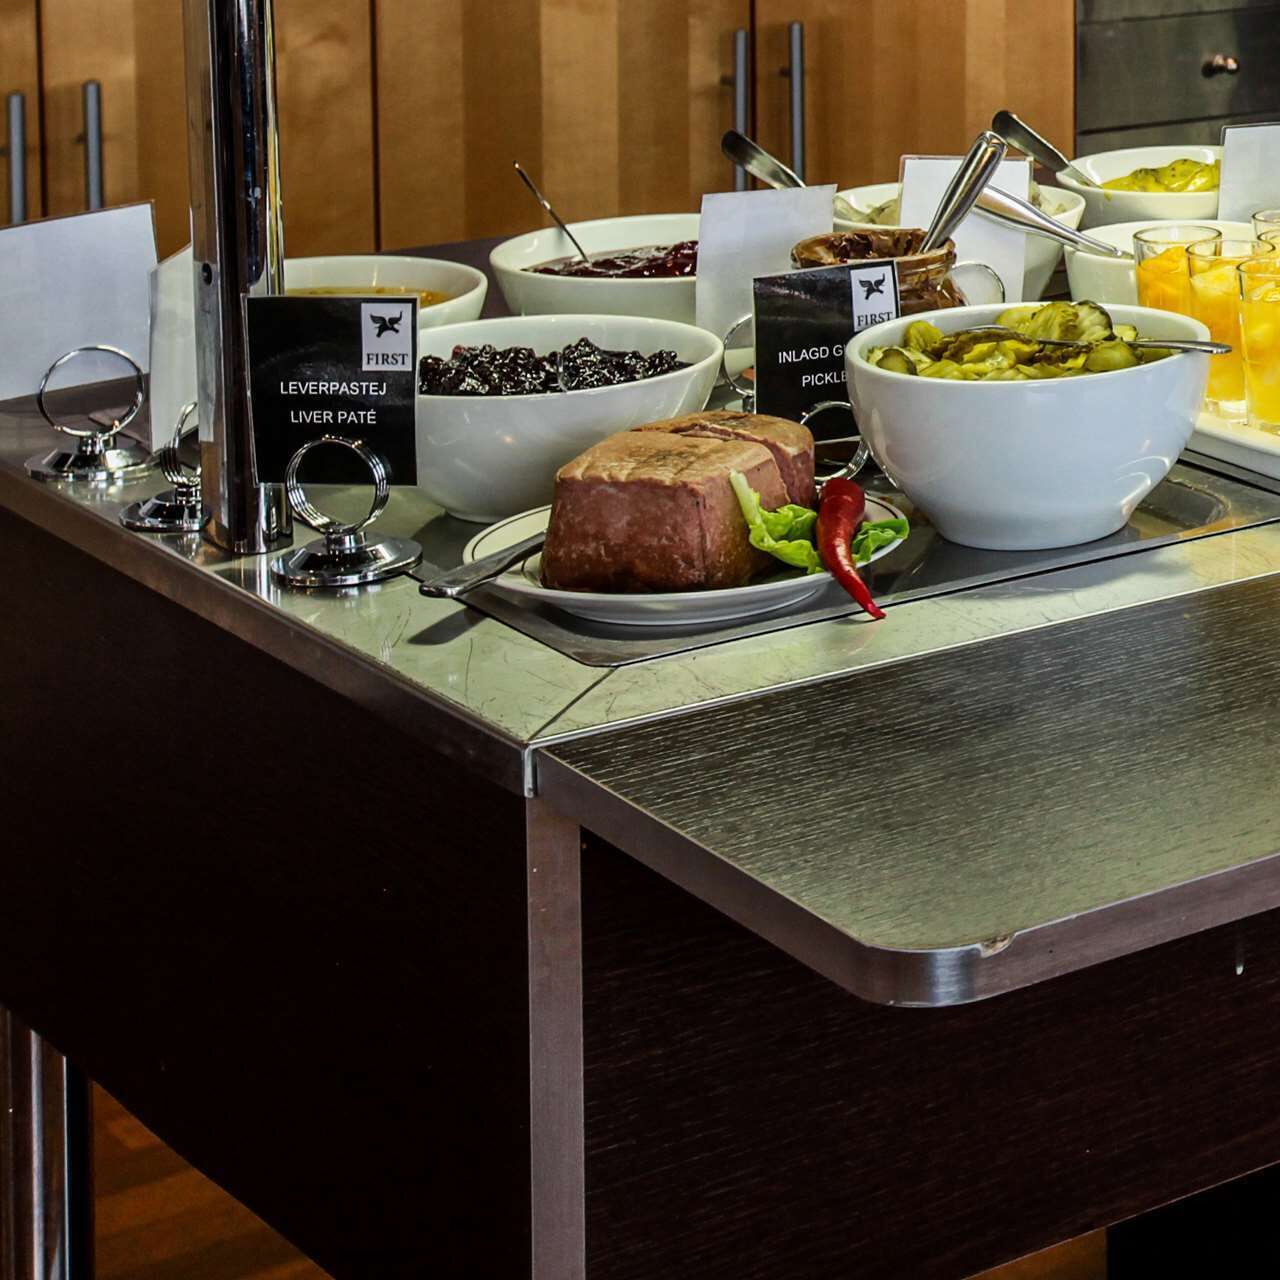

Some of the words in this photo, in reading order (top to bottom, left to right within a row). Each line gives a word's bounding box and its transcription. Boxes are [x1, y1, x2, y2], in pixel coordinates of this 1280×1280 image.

[857, 311, 893, 327] FIRST
[366, 353, 409, 366] FIRST
[778, 346, 829, 364] INLAGD
[832, 344, 847, 357] G
[280, 381, 387, 396] LEVERPASTEJ
[290, 410, 334, 424] LIVER
[337, 409, 377, 424] PATÉ
